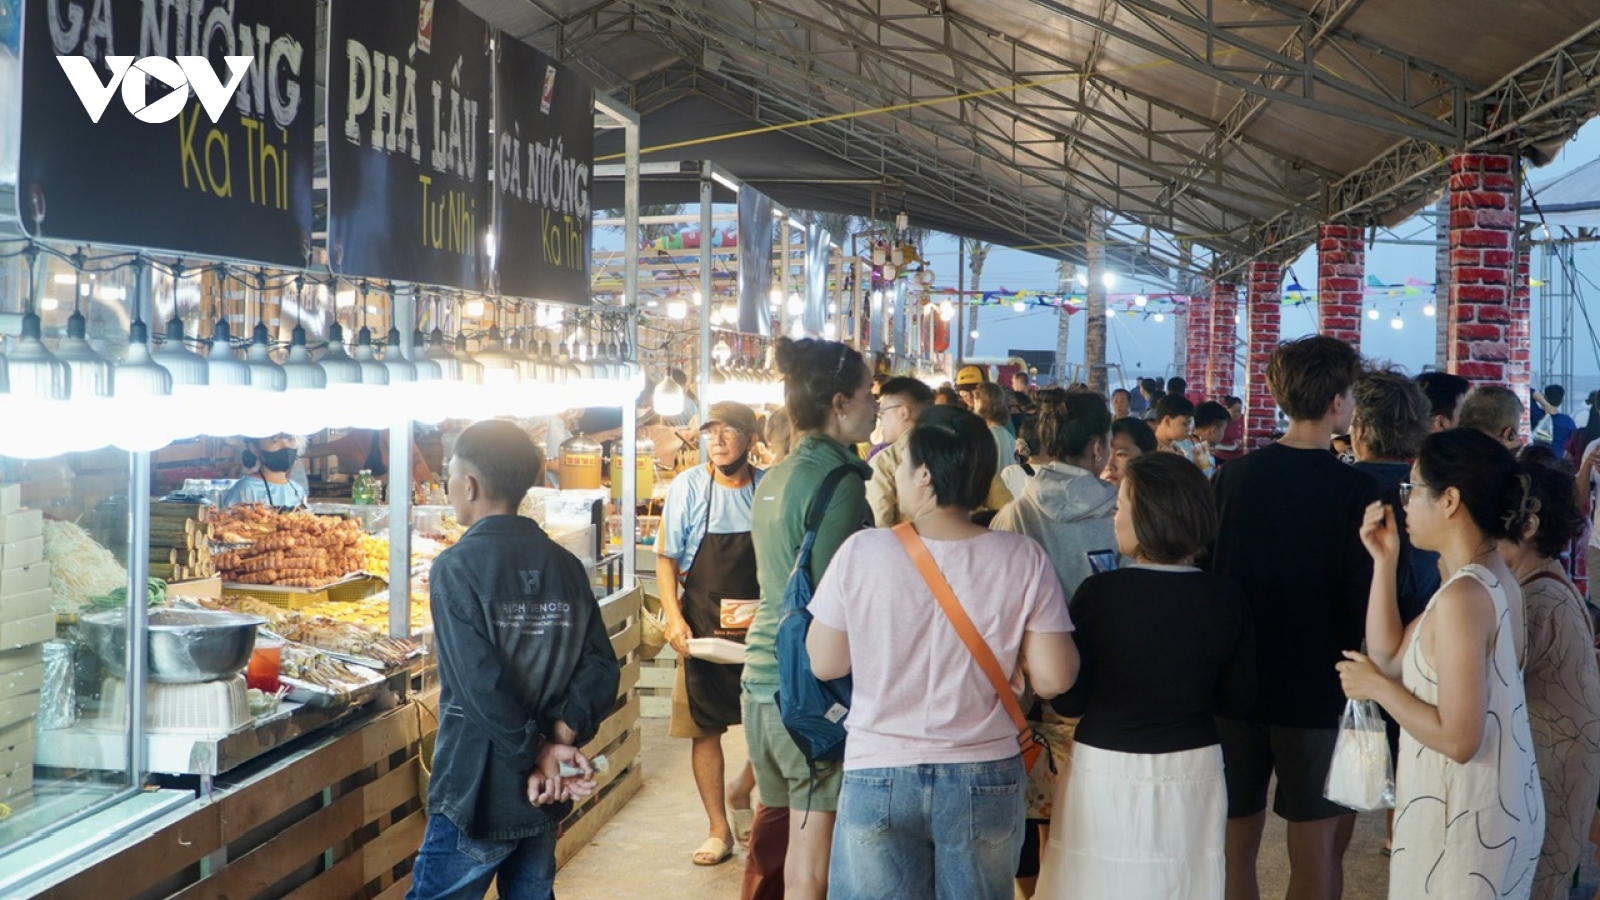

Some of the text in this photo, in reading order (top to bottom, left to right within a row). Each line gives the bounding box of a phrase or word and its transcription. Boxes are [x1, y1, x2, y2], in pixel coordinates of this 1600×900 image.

[178, 102, 289, 211] Ka Thi
[344, 38, 479, 182] PHÁ LẤU
[418, 174, 447, 250] Tư
[500, 120, 590, 219] GÀ NƯỚNG
[540, 208, 583, 271] Ka Thi
